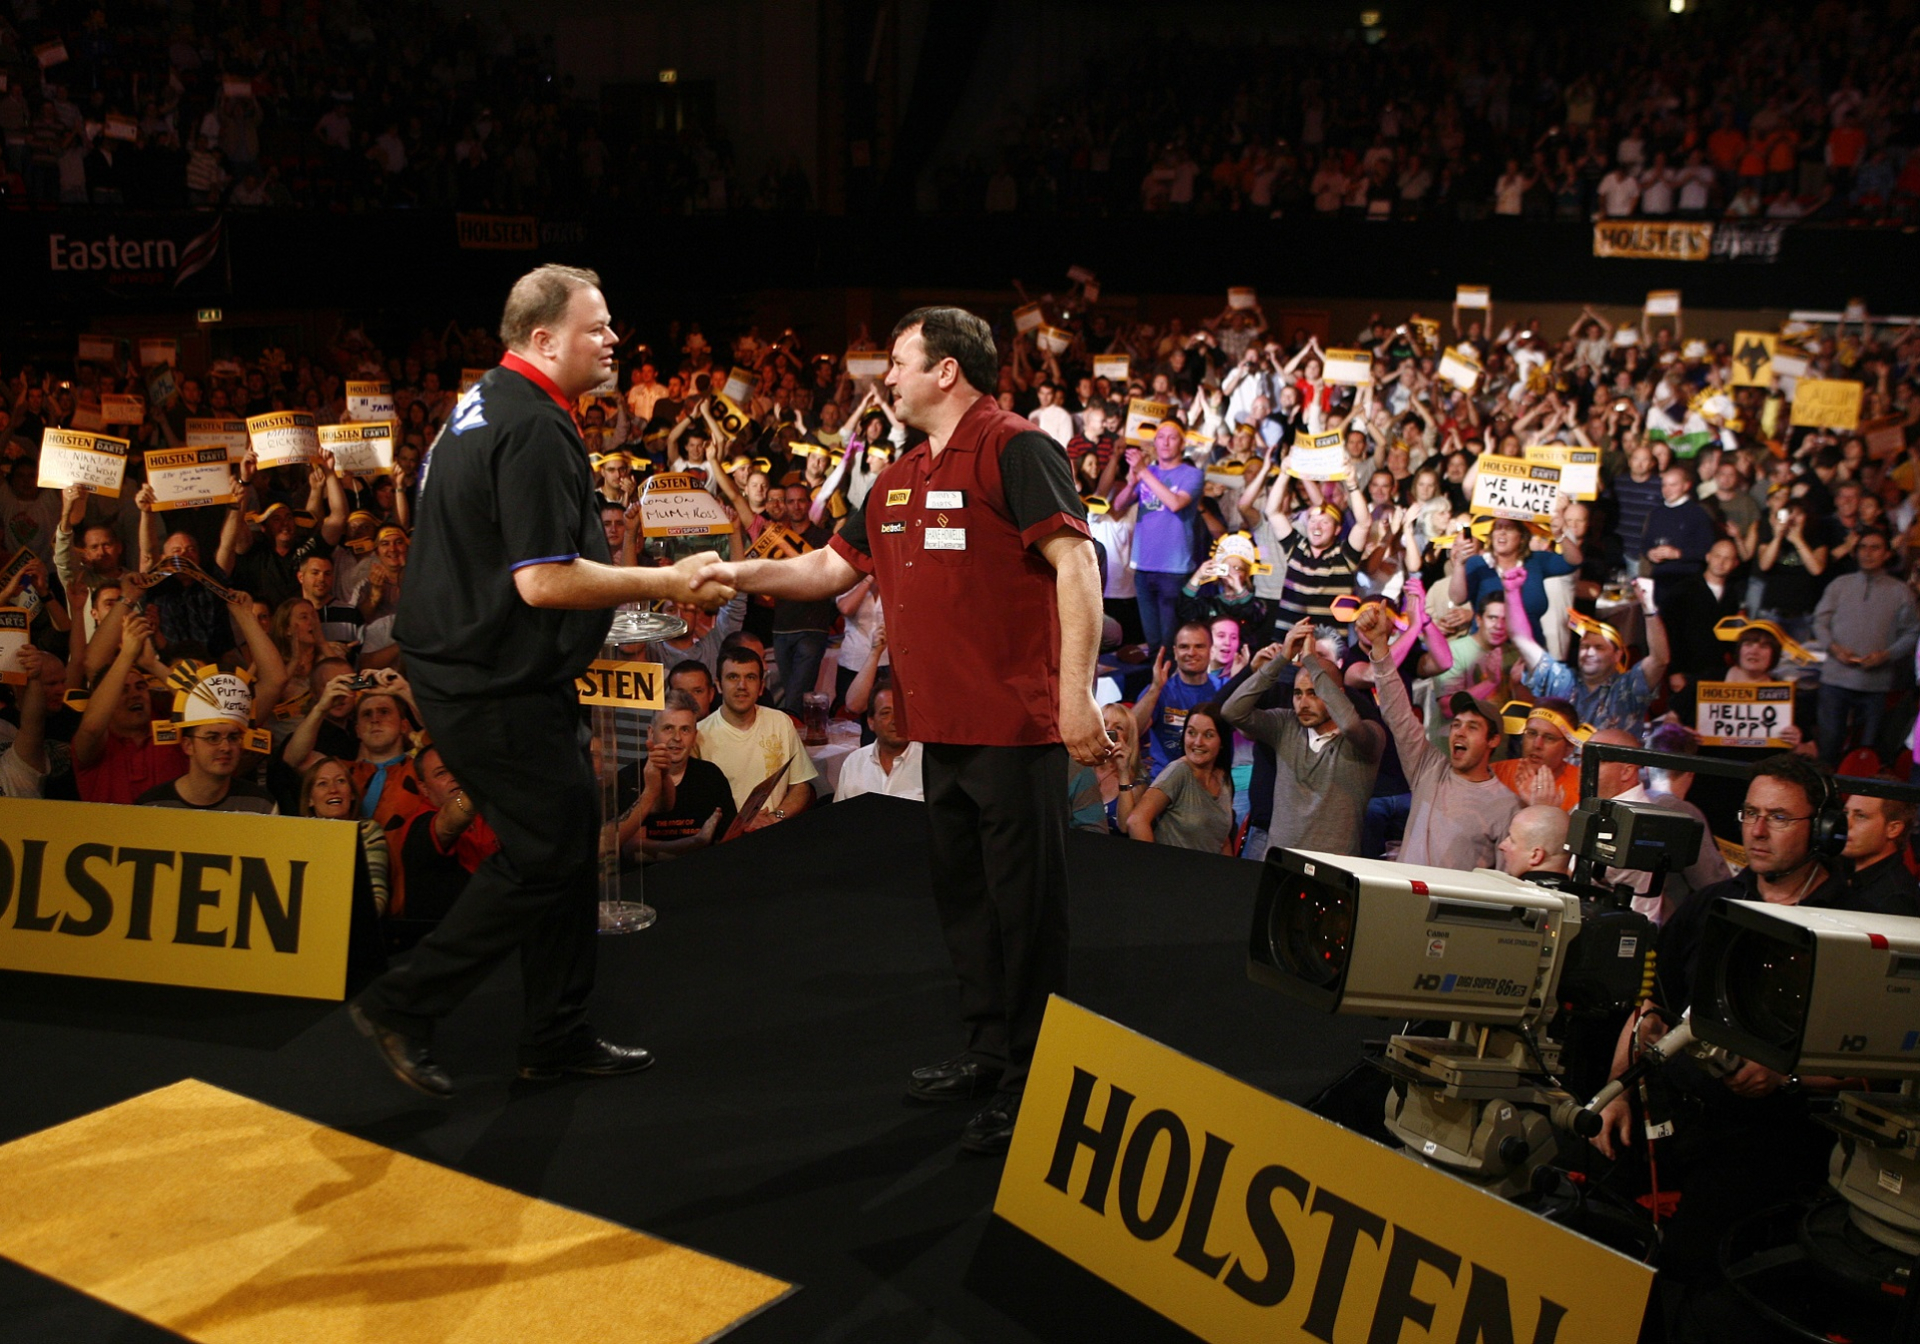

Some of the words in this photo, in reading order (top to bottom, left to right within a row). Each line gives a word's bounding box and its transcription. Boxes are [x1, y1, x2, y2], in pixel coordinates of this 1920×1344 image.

[460, 221, 532, 241] HOLSTEN
[1602, 229, 1702, 250] HOLSTEN
[49, 233, 178, 271] Eastern
[252, 416, 292, 430] HOLSTEN
[322, 431, 360, 440] HOLSTEN
[364, 428, 388, 438] DARTS
[48, 434, 92, 447] HOLSTEN
[96, 442, 124, 454] DARTS
[150, 453, 194, 466] HOLSTEN
[200, 452, 226, 462] DARTS
[1483, 461, 1526, 475] HOLSTEN
[1531, 469, 1558, 481] DARTS
[1484, 476, 1508, 492] WE
[1521, 482, 1556, 498] HATE
[1488, 493, 1550, 514] PALACE
[682, 526, 708, 534] SPORTS
[0, 618, 26, 628] ARTS
[208, 677, 236, 687] JEAN
[580, 668, 654, 700] STEN
[217, 688, 236, 697] PUT
[1703, 688, 1752, 698] HOLSTEN
[1709, 704, 1776, 722] HELLO
[1714, 720, 1777, 738] POPPY
[0, 837, 309, 954] LSTEN
[1426, 929, 1450, 939] Canon
[1413, 974, 1442, 991] HD
[1456, 976, 1472, 988] DIGI
[1472, 976, 1498, 990] SUPER
[1496, 980, 1514, 996] 86
[1886, 984, 1911, 993] Canon
[1839, 1034, 1868, 1052] HD
[1044, 1065, 1569, 1344] HOLSTEN
